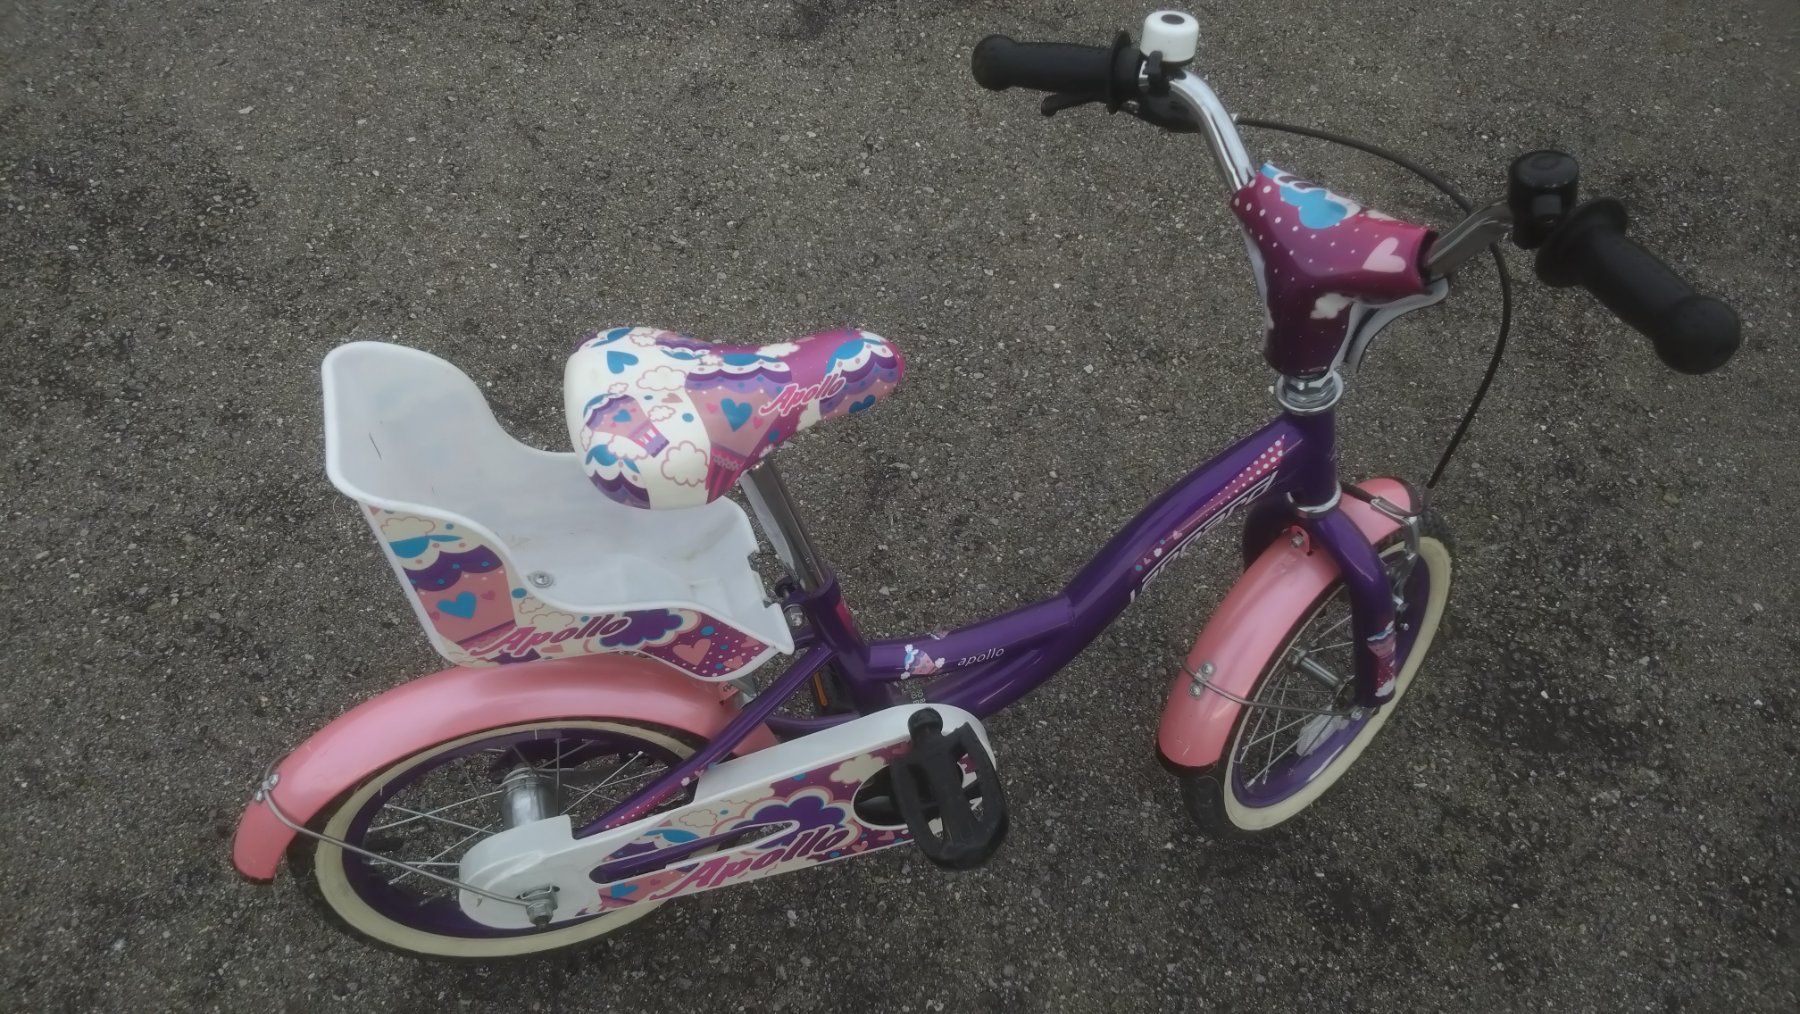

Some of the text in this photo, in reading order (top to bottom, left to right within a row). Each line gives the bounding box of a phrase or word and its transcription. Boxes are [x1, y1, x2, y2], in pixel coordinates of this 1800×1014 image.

[759, 371, 847, 416] Apollo
[469, 613, 632, 657] Apollo
[957, 647, 1005, 667] apollo
[649, 823, 852, 900] Apollo
